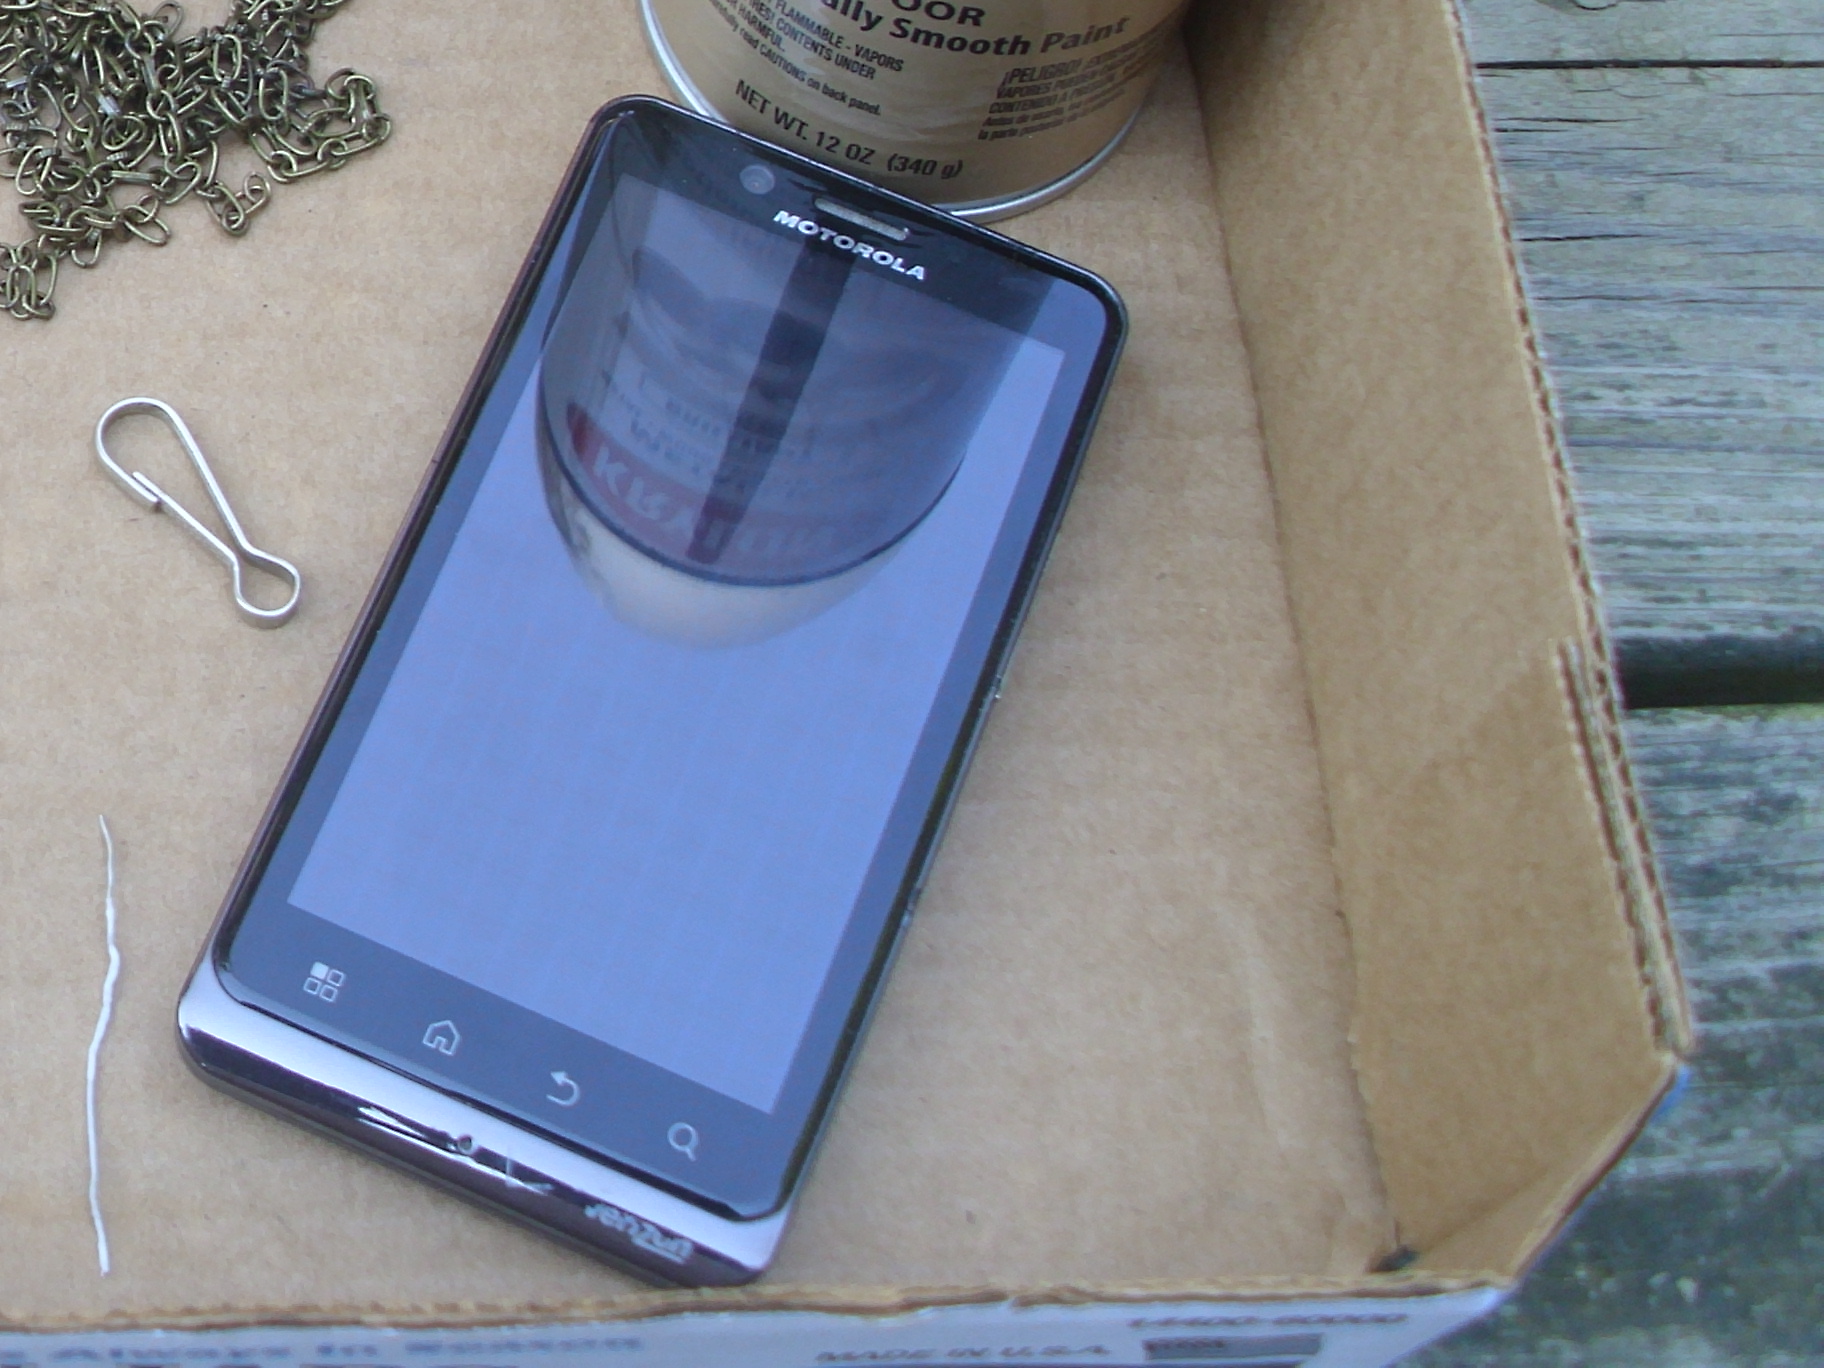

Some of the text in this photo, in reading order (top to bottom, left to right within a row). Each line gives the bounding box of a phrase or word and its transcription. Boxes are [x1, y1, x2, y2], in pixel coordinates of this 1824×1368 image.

[737, 3, 786, 53] HARMFUL.
[775, 16, 832, 62] CONTENTS
[834, 53, 877, 81] UNDER
[853, 43, 905, 72] VAPORS
[889, 16, 1032, 56] Smooth
[1039, 17, 1131, 55] Paint
[759, 43, 808, 83] CAUTIONS
[806, 77, 821, 91] on
[821, 82, 849, 103] back
[735, 79, 964, 181] NET WT. 12 OZ (340 g)
[772, 209, 926, 281] MOTOROLA
